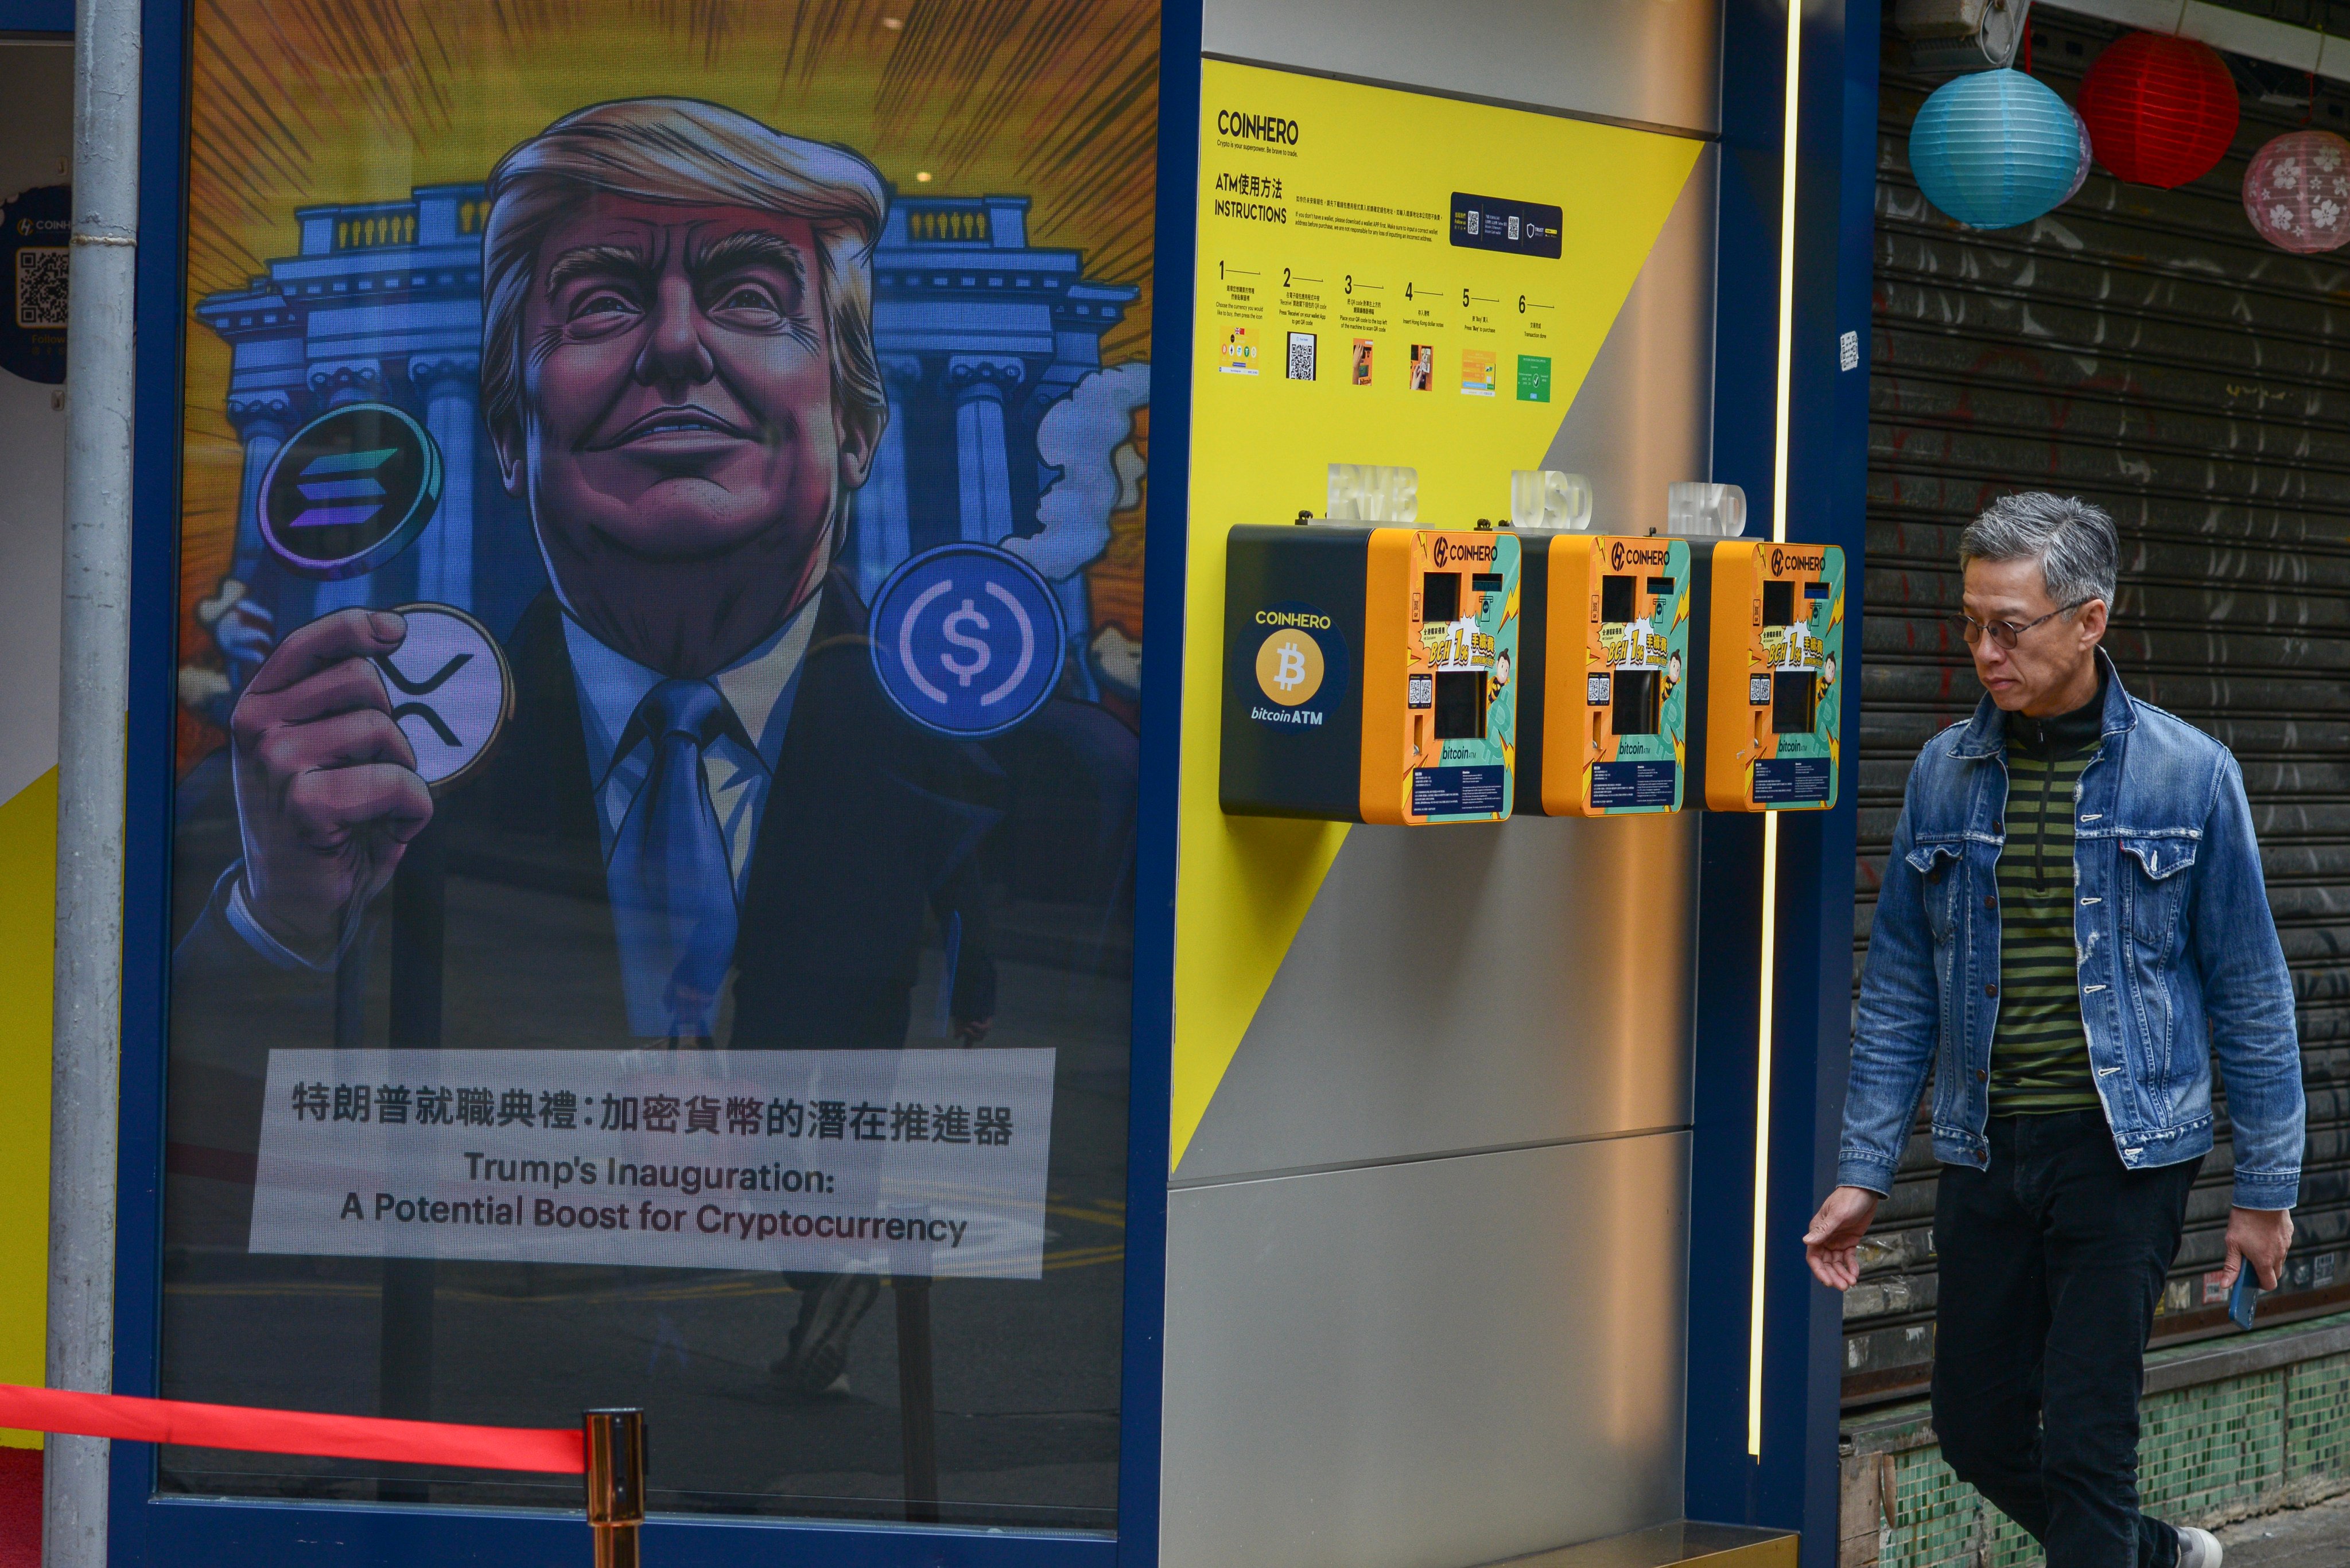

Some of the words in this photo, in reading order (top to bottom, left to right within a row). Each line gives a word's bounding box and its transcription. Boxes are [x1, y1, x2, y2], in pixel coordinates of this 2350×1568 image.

[1218, 110, 1299, 145] COINHERO
[1217, 139, 1230, 147] Crypto
[1215, 173, 1282, 200] ATM使用方法
[1215, 199, 1287, 224] INSTRUCTIONS
[36, 220, 70, 229] COINH
[1389, 231, 1402, 239] inputting
[1219, 260, 1224, 280] 1
[1283, 267, 1291, 287] 2
[1345, 275, 1352, 294] 3
[1405, 282, 1413, 301] 4
[1463, 289, 1469, 307] 5
[1518, 295, 1525, 313] 6
[32, 334, 65, 344] Follow
[1327, 463, 1419, 523] RMB
[1511, 470, 1592, 530] USD
[1667, 482, 1746, 537] HKD
[1450, 545, 1498, 562] COINHERO
[1626, 549, 1670, 566] COINHERO
[1785, 556, 1825, 571] COINHERO
[1256, 611, 1331, 629] COINHERO
[1429, 640, 1452, 664] BCH
[1454, 628, 1469, 663] 1%
[1471, 633, 1495, 653] 手續費
[1608, 640, 1629, 664] BCH
[1631, 629, 1644, 663] 1%
[1646, 633, 1668, 653] 手續費
[1769, 642, 1787, 664] BCH
[1789, 632, 1801, 663] 1%
[1804, 636, 1823, 656] 手續費
[1251, 707, 1291, 722] bitcoin
[1291, 710, 1323, 725] ATM
[1443, 746, 1469, 760] bitcoin
[1619, 742, 1643, 755] bitcoin
[1778, 740, 1801, 752] bitcoin
[464, 1151, 597, 1189] Trump's
[608, 1157, 834, 1195] Inauguration:
[341, 1192, 364, 1220] A
[375, 1193, 523, 1226] Potential
[534, 1198, 629, 1230] Boost
[639, 1200, 686, 1232] for
[697, 1204, 968, 1248] Cryptocurrency
